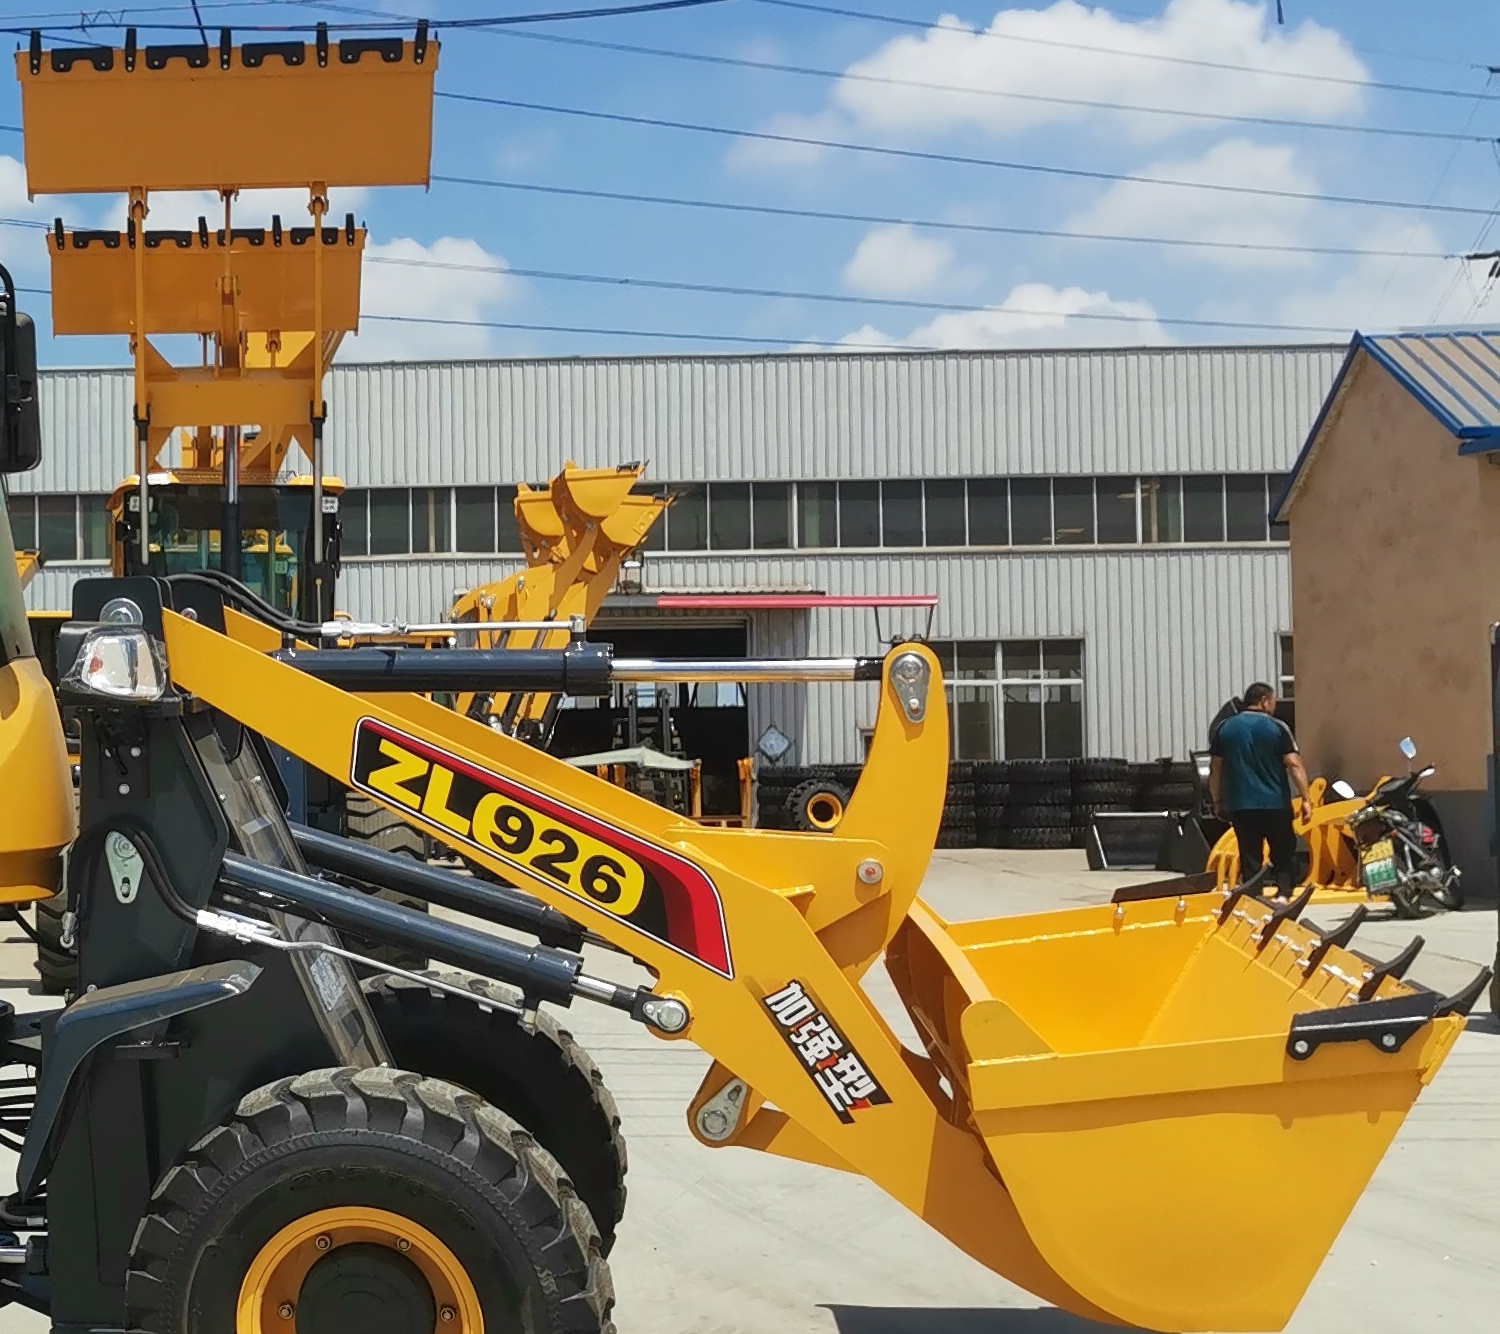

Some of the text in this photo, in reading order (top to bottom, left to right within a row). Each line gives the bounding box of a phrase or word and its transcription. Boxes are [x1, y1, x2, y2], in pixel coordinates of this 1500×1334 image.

[367, 738, 628, 905] ZL926
[764, 981, 877, 1111] 加强型
